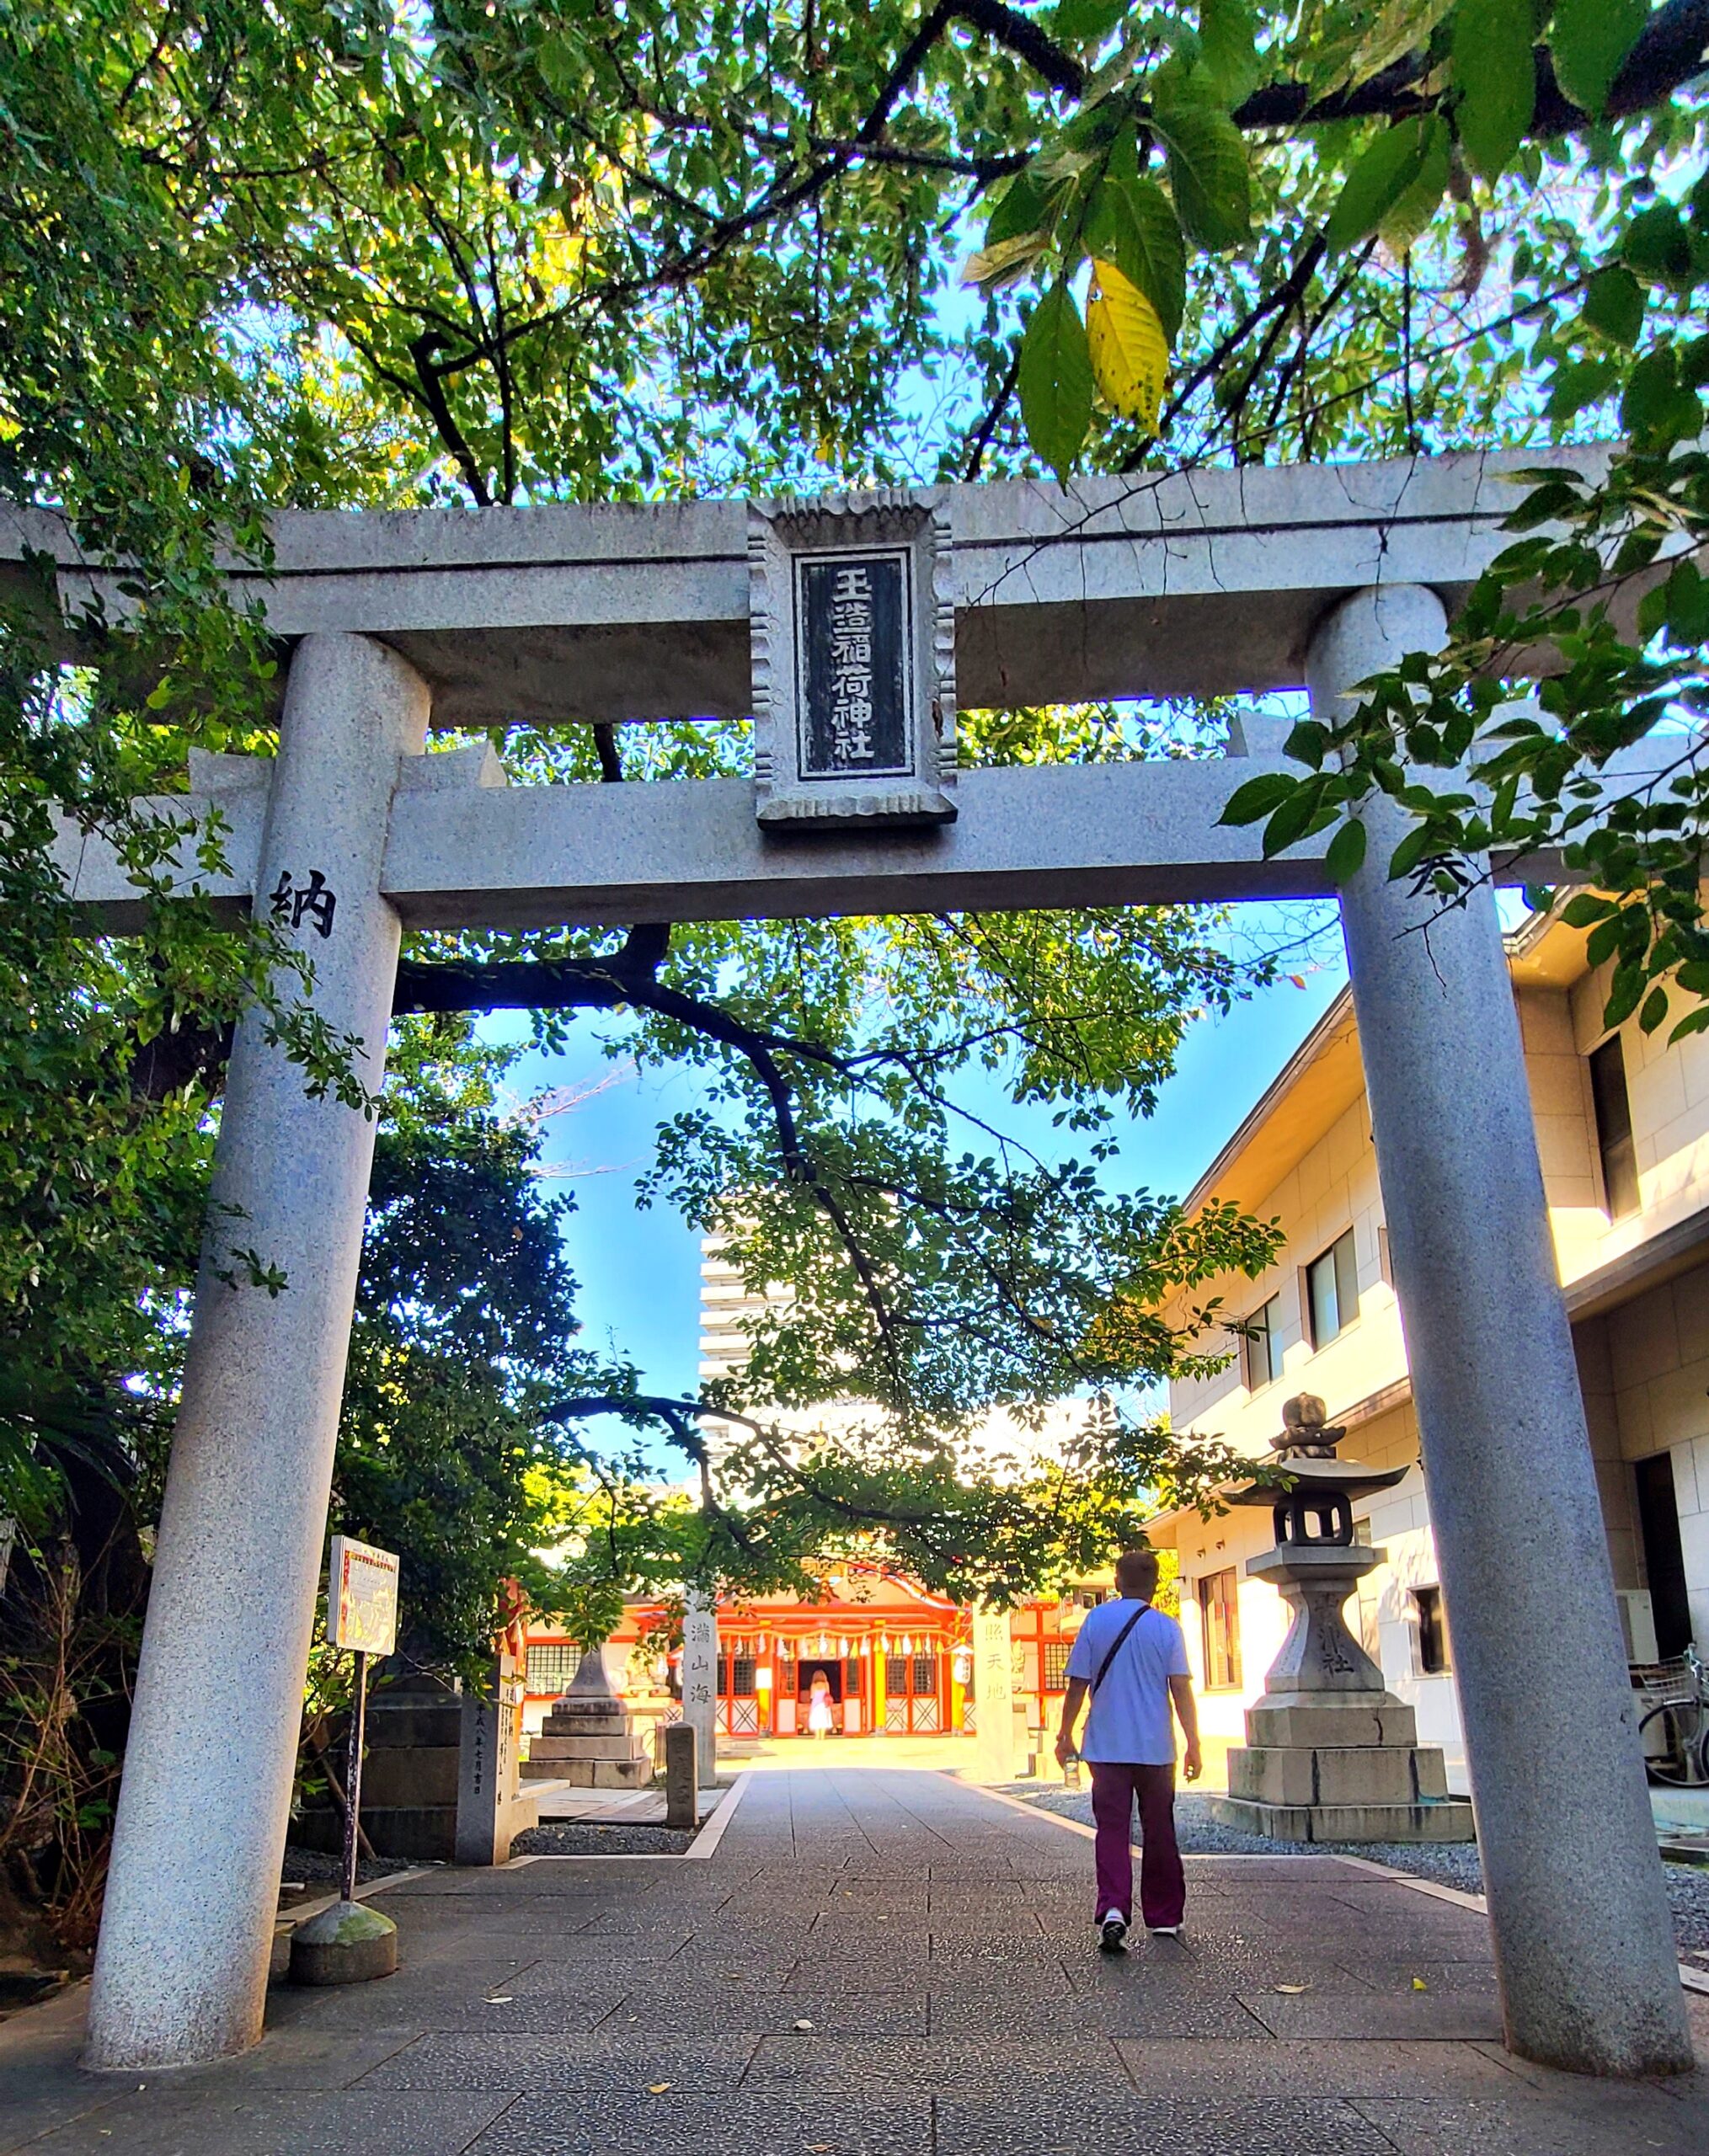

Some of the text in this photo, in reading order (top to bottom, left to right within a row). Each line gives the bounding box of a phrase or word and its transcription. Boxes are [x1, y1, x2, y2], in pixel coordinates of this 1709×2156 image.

[830, 568, 875, 760] 玉造稲荷神社
[268, 868, 337, 939] 納
